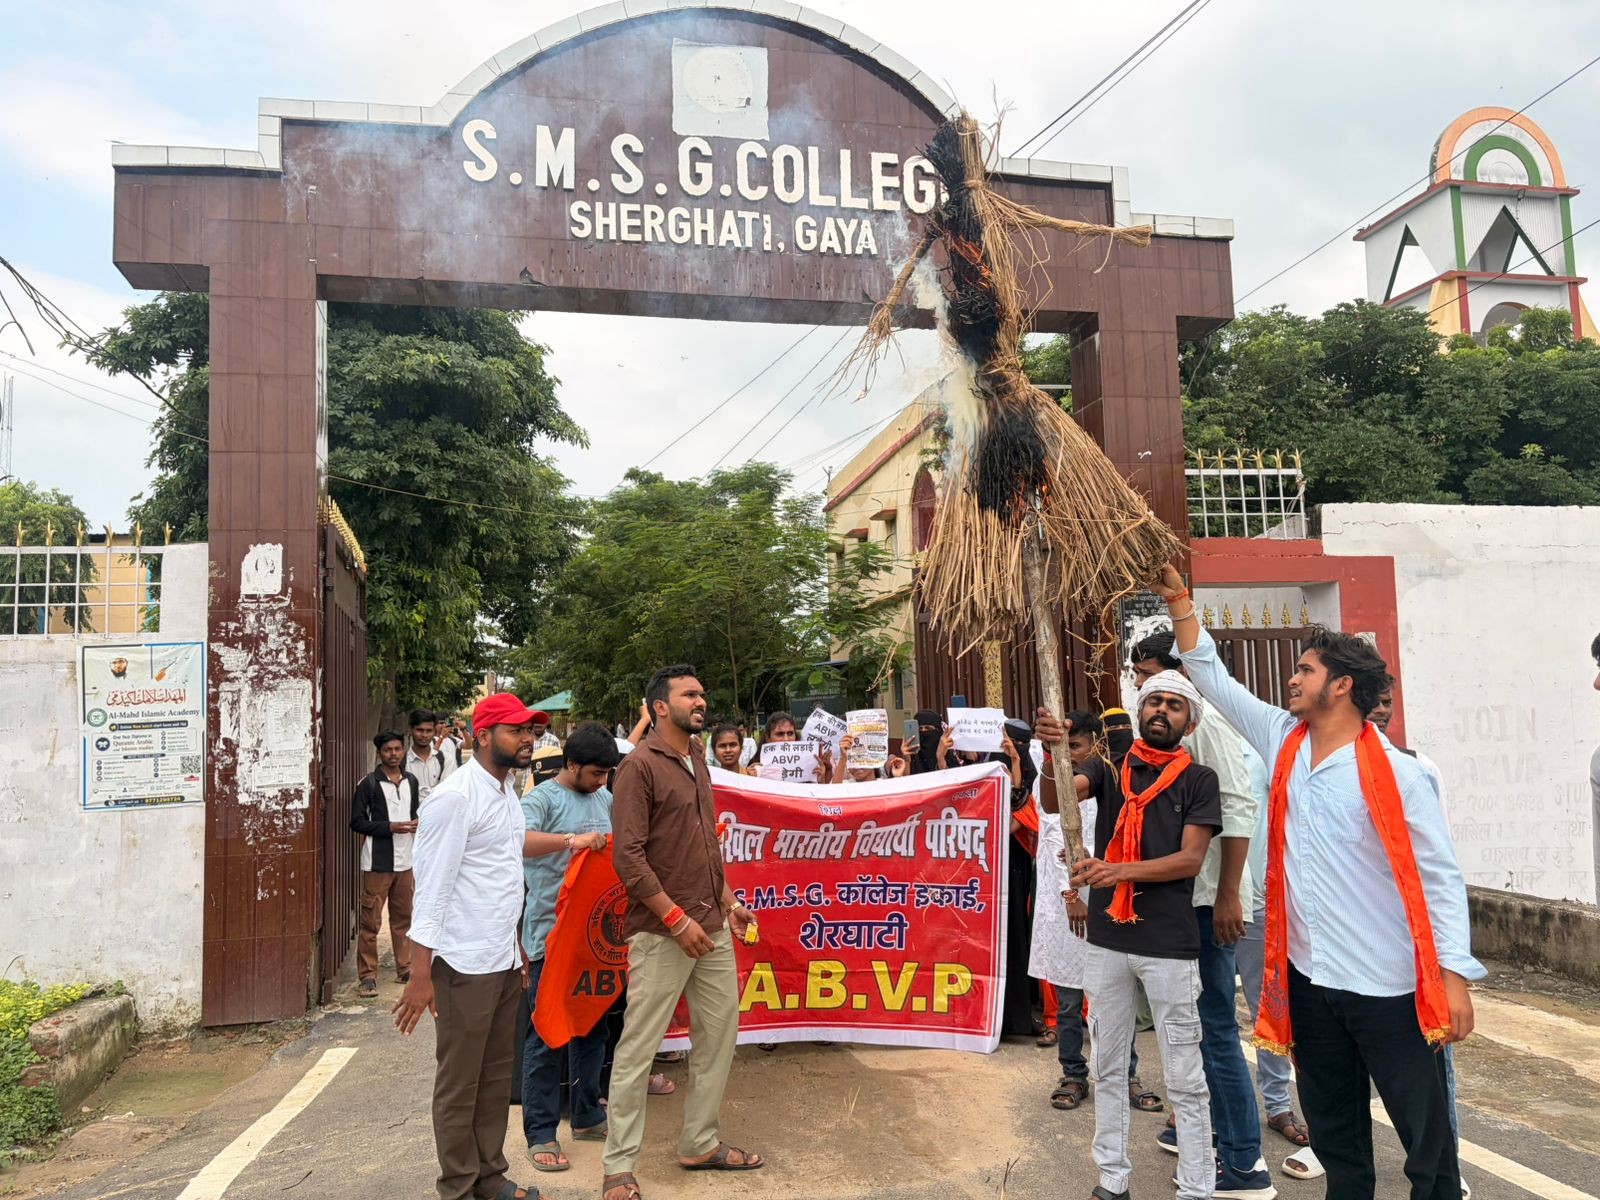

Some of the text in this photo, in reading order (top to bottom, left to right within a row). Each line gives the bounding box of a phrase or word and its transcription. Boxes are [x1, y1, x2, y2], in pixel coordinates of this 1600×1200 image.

[736, 141, 950, 215] COLLEG
[569, 200, 878, 255] SHERGHATI, GAYA
[108, 708, 200, 719] Al-Mahd Islamic Academy
[814, 723, 837, 737] ABVP
[1454, 704, 1539, 743] JOIN
[771, 755, 801, 764] ABVP
[773, 822, 853, 859] भारतीय
[836, 874, 910, 906] कॉलेज
[799, 912, 909, 949] शेरघाटी
[571, 970, 629, 997] AB
[738, 959, 974, 1013] A.B.V.P
